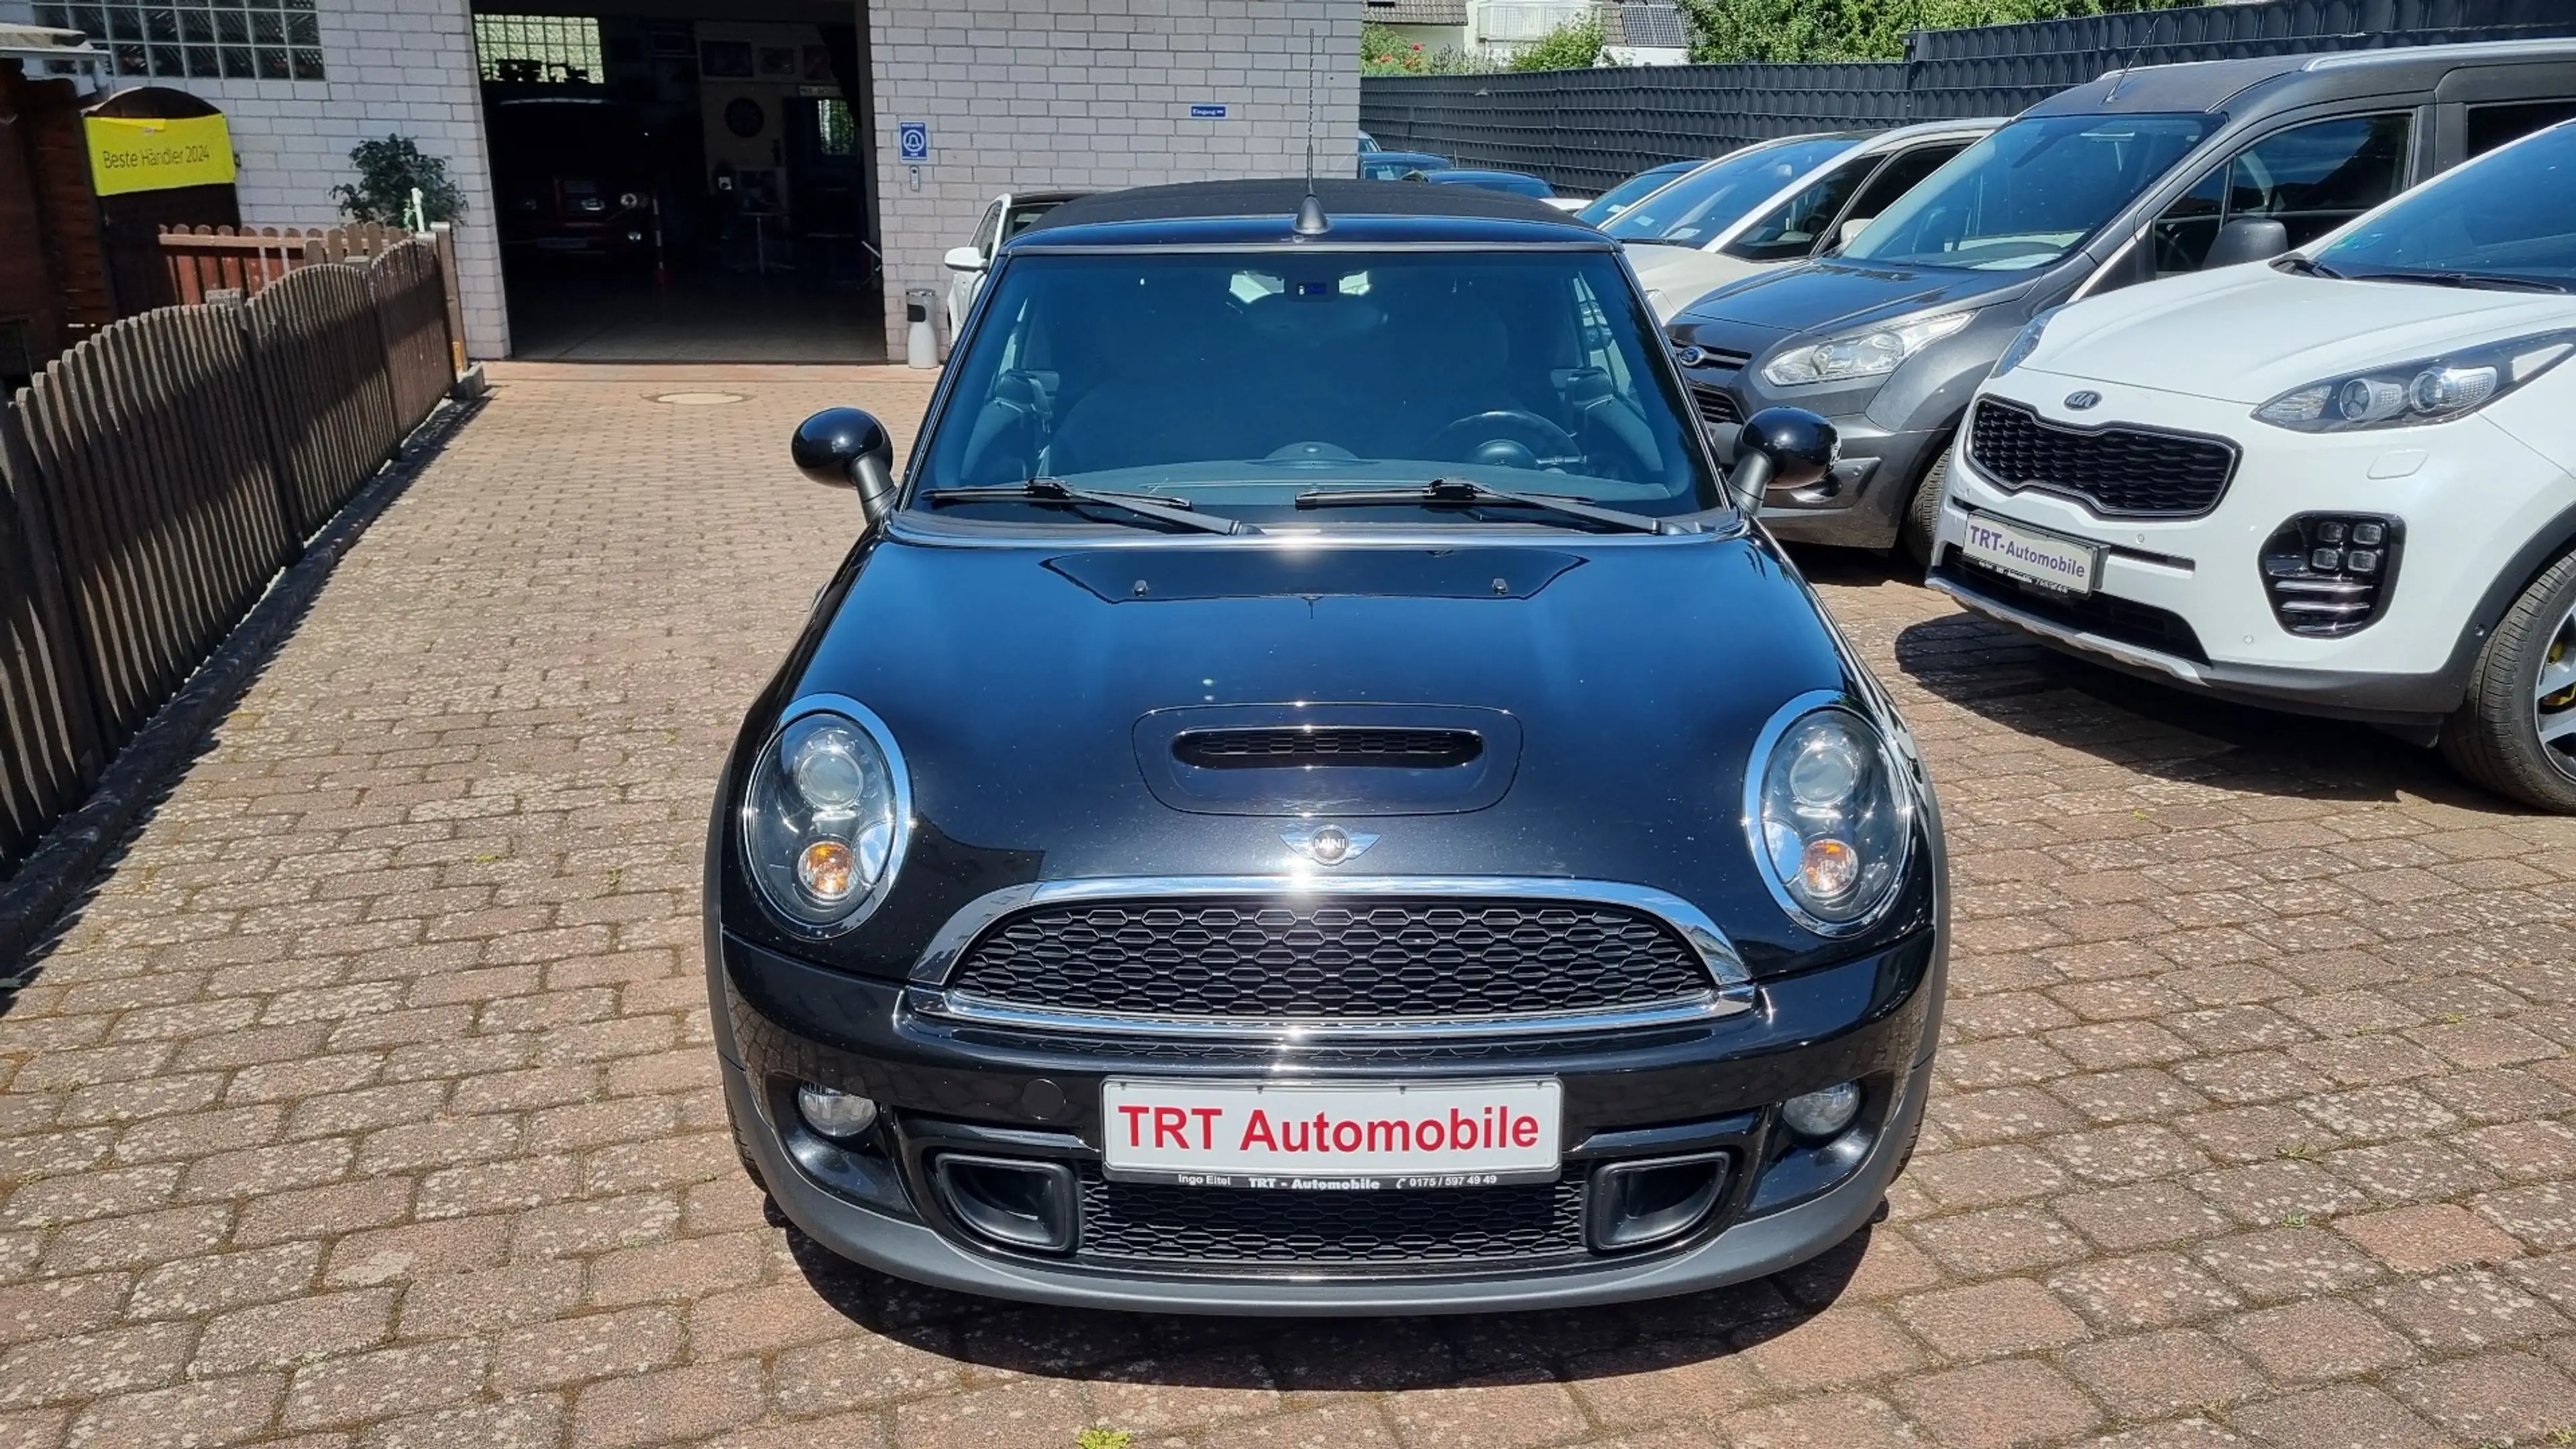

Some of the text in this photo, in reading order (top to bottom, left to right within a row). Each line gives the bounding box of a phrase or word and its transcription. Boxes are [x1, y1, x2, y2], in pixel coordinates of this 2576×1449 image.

[103, 145, 211, 168] Beste Händler 2024
[1970, 525, 2085, 578] TRT-Automobile
[1315, 839, 1345, 849] MINI
[1118, 1105, 1539, 1152] TRT Automobile
[1178, 1174, 1203, 1185] Ingo
[1206, 1175, 1231, 1185] Eitel
[1248, 1177, 1277, 1188] TRT
[1291, 1178, 1381, 1189] Automobile
[1409, 1177, 1436, 1187] 0175
[1445, 1175, 1463, 1185] 597
[1466, 1175, 1481, 1185] 49
[1483, 1174, 1498, 1184] 49
